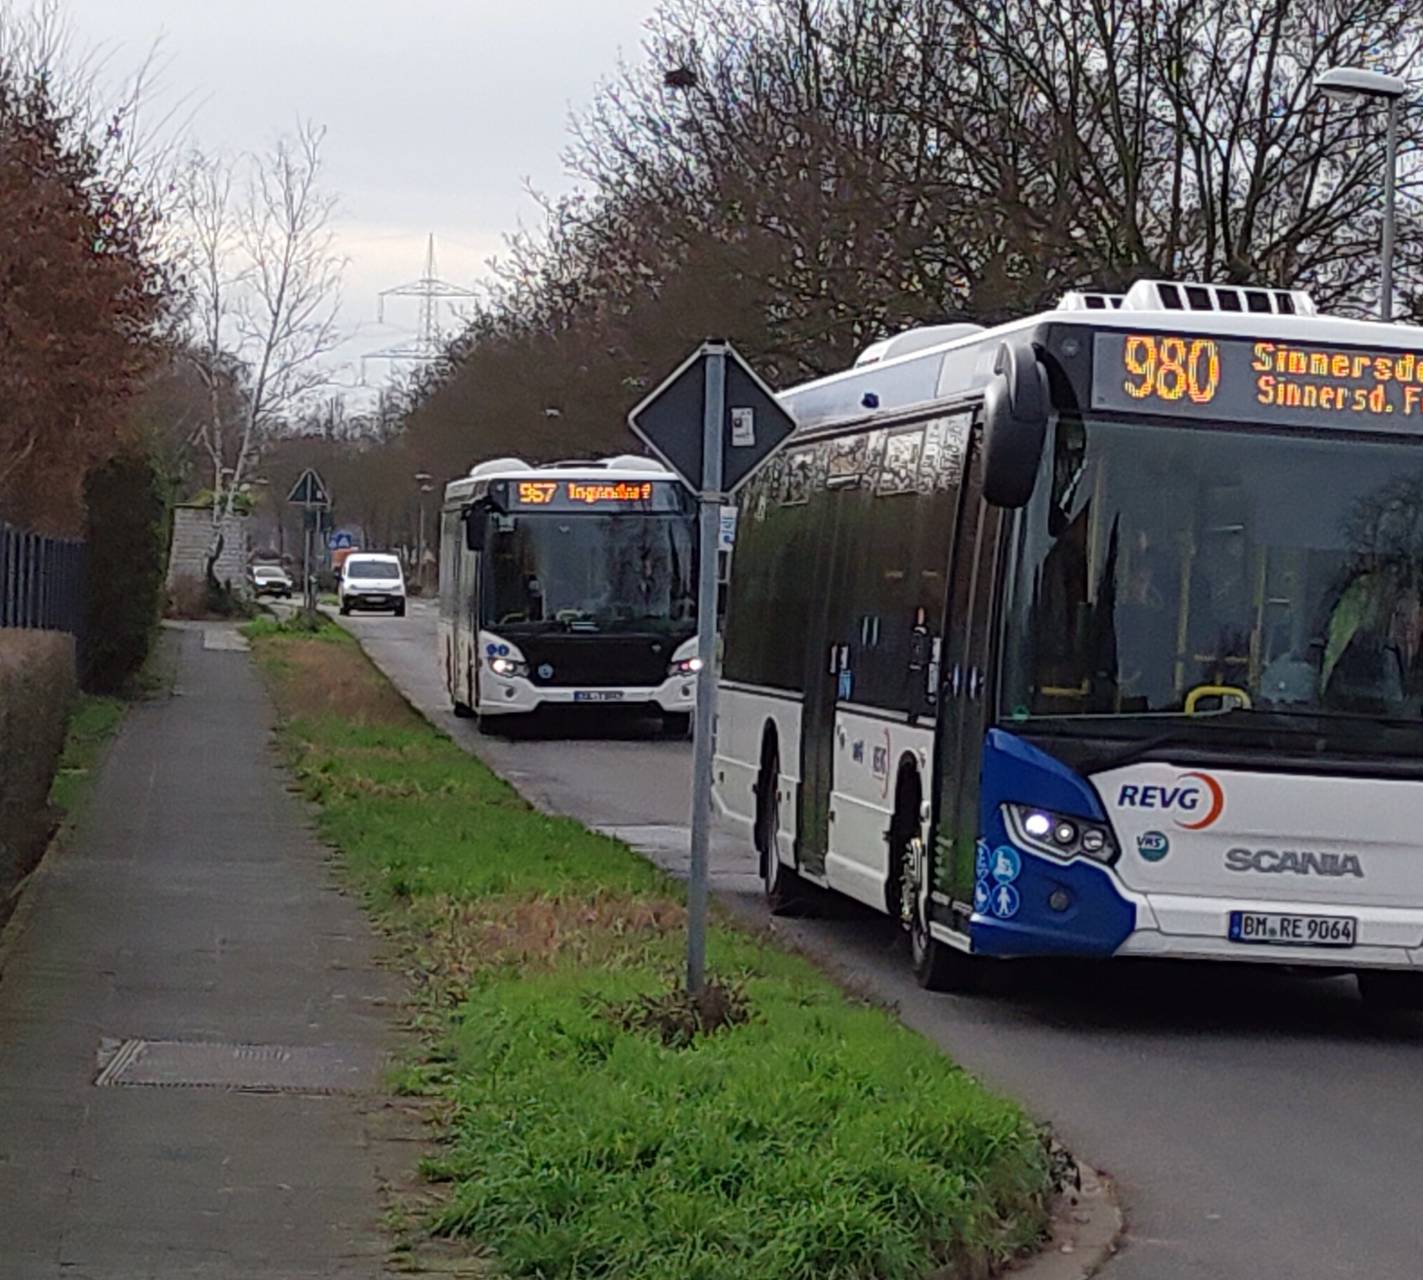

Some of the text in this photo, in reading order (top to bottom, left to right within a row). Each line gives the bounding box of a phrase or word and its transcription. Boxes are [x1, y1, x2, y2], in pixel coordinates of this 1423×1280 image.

[1124, 335, 1221, 403] 980
[1257, 375, 1393, 413] Sinnersd.
[1117, 785, 1199, 810] REVG
[1225, 848, 1364, 878] SCANIA
[1244, 916, 1351, 941] BM RE 9064
